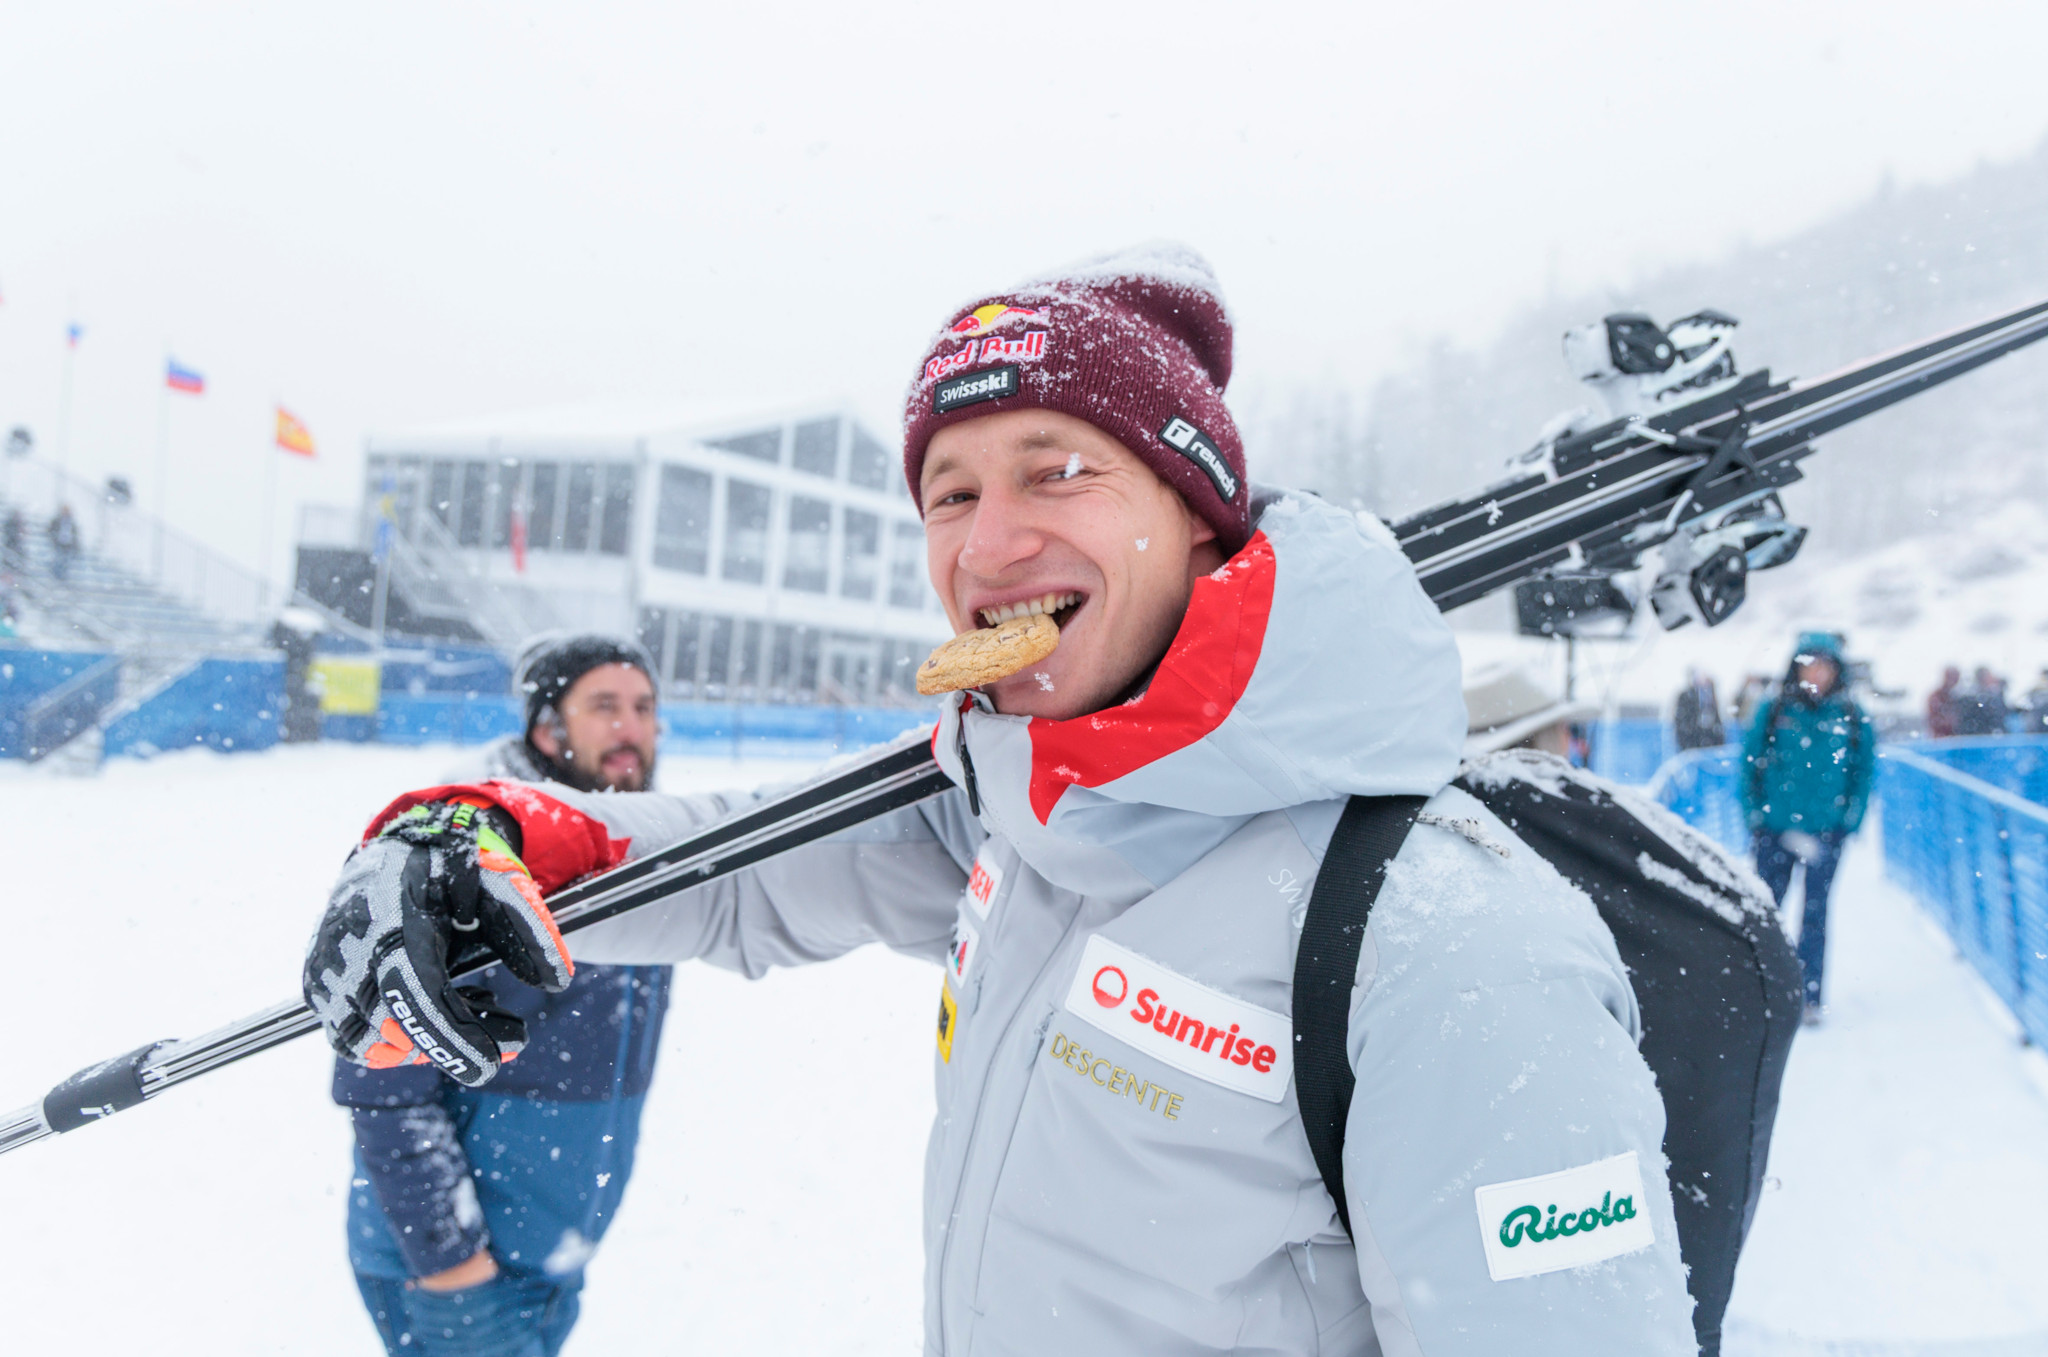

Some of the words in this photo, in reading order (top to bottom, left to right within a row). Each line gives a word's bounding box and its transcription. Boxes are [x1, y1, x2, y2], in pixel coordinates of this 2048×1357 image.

[924, 340, 975, 382] Red
[979, 332, 1046, 362] Bull
[1190, 441, 1236, 498] reusch
[384, 988, 468, 1075] reusch
[1130, 988, 1277, 1073] Sunrise
[1049, 1031, 1184, 1121] DESCENTE
[1499, 1190, 1637, 1248] Ricola
